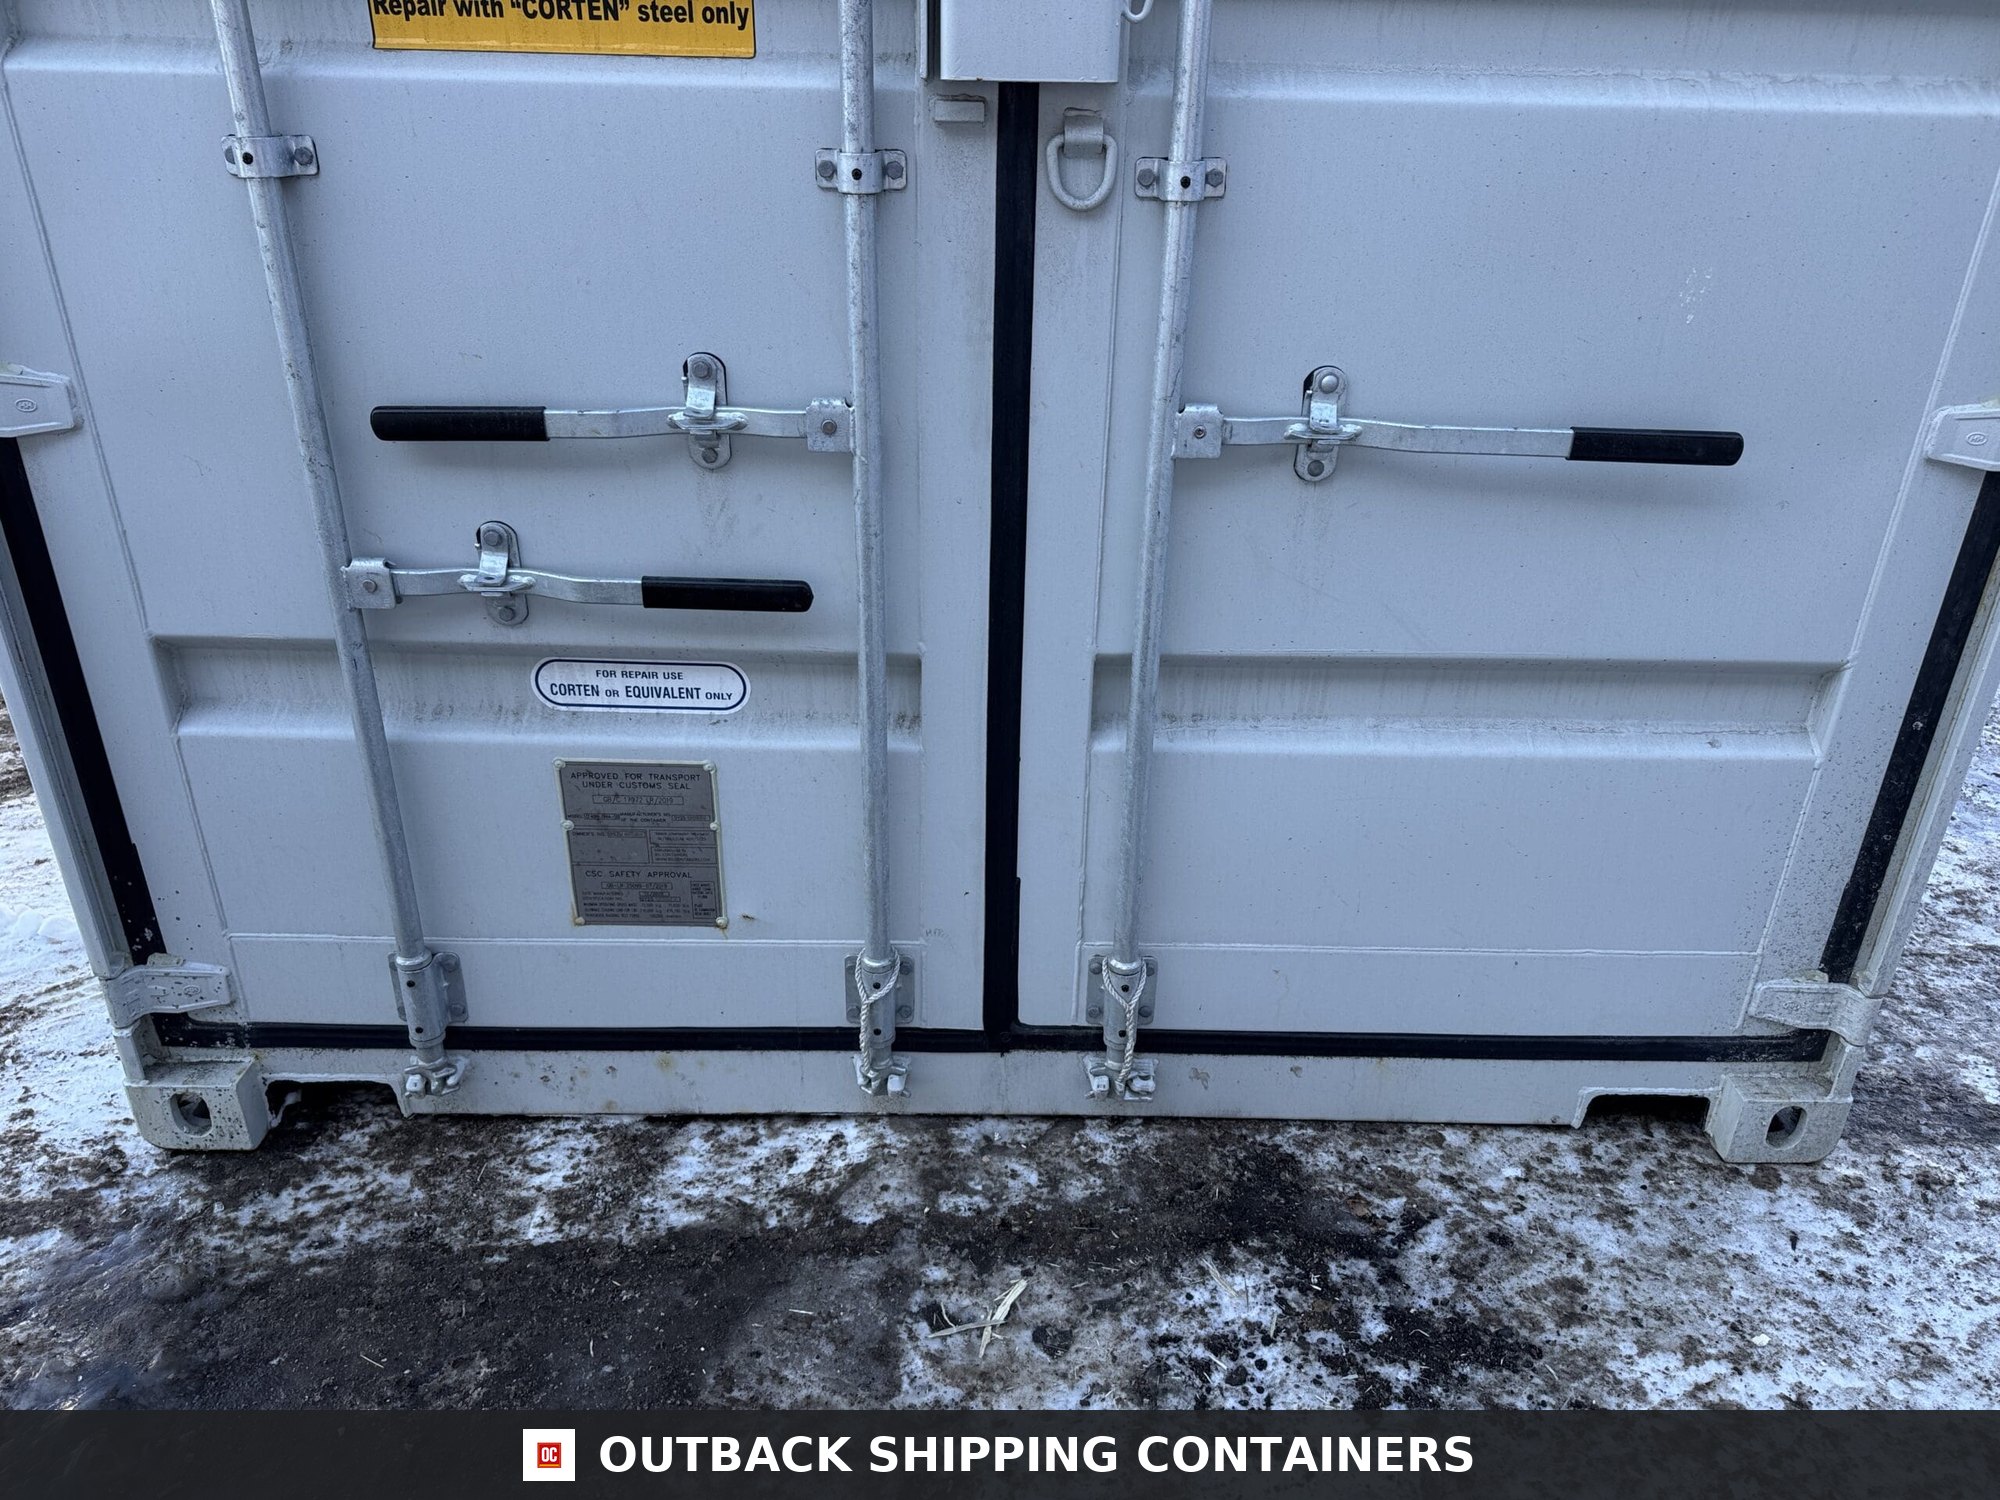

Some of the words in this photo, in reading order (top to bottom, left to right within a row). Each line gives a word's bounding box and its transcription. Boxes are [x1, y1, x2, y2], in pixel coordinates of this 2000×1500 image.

[375, 0, 446, 21] Repair
[452, 0, 504, 17] with
[638, 0, 694, 23] steel
[702, 1, 749, 31] only
[596, 669, 617, 678] FOR
[621, 670, 659, 679] REPAIR
[663, 672, 684, 680] USE
[550, 683, 600, 697] CORTEN
[605, 689, 620, 698] OR
[625, 685, 702, 700] EQUIVALENT
[705, 691, 733, 700] ONLY
[570, 772, 619, 780] APPROVED
[649, 773, 701, 781] TRANSPORT
[647, 871, 693, 879] APPROVAL
